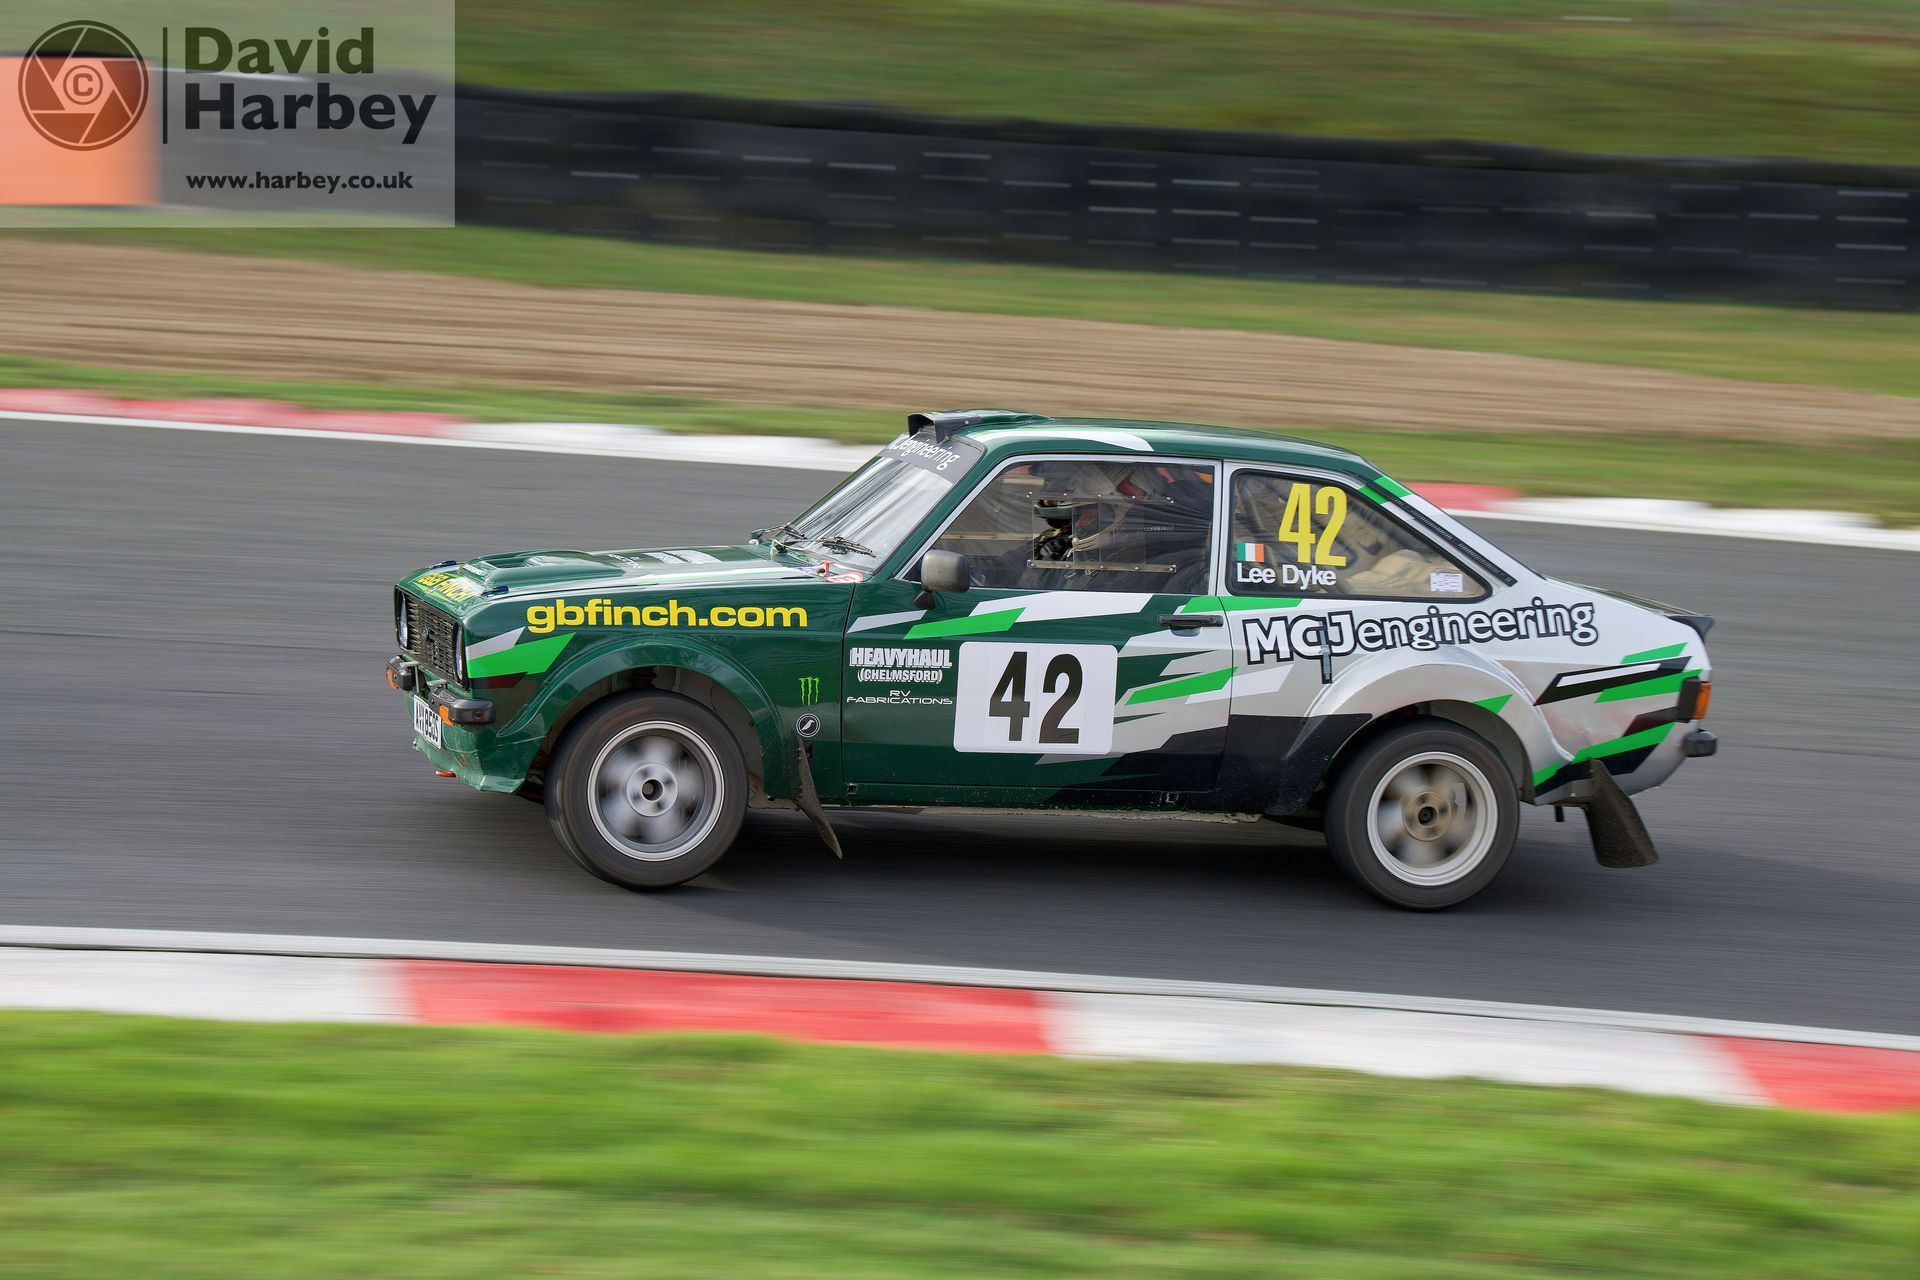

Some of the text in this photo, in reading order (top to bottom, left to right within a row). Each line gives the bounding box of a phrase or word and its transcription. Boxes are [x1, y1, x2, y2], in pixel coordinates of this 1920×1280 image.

[1278, 483, 1348, 567] 42
[1236, 564, 1337, 590] Lee Dyke
[526, 599, 809, 633] gbfinch.com
[849, 647, 952, 668] HEAVYHAUL
[857, 669, 943, 684] (CHELMSFORD)
[846, 696, 953, 705] FABRICATIONS
[988, 651, 1083, 745] 42
